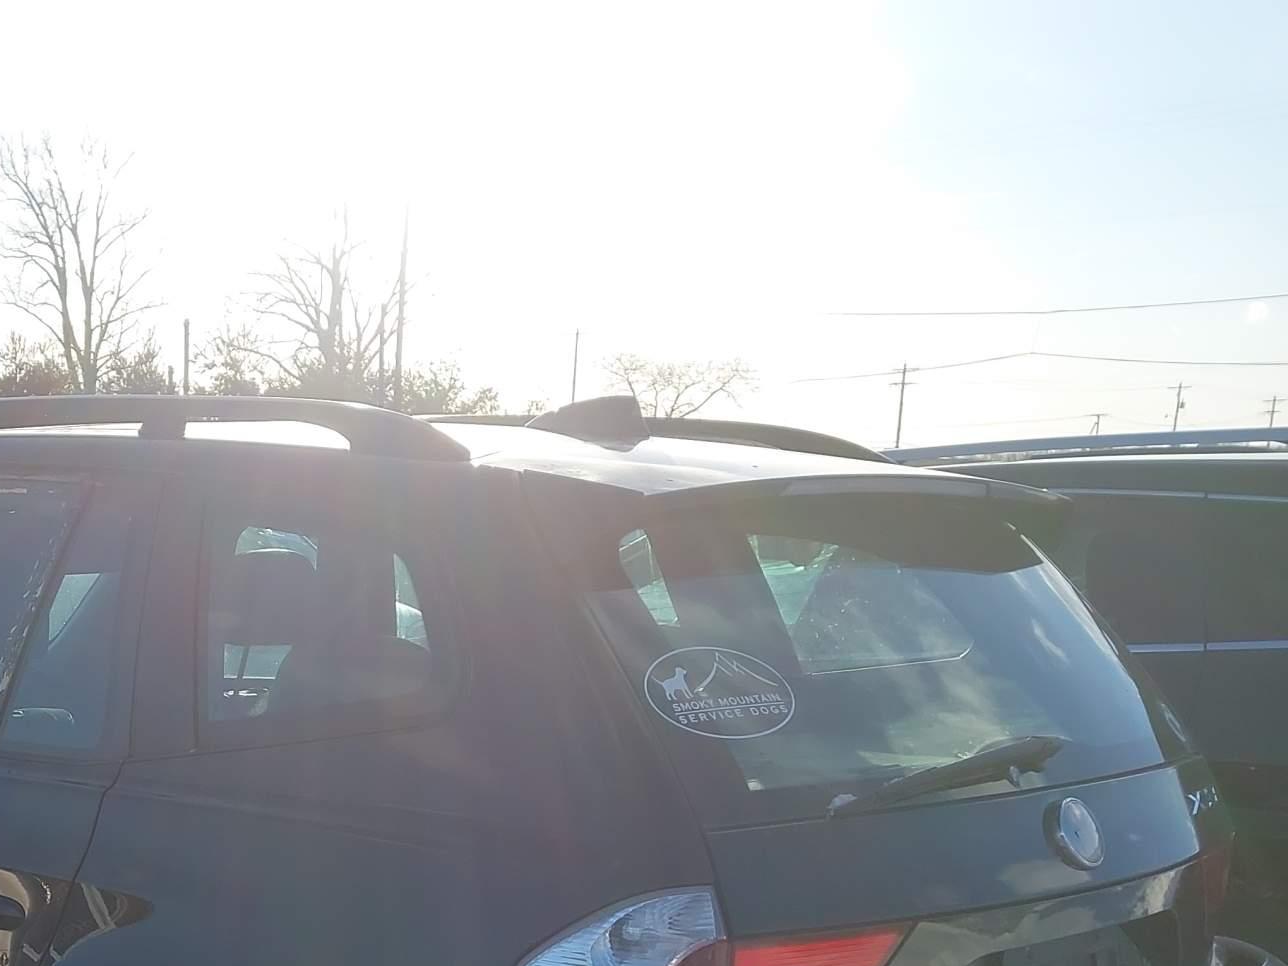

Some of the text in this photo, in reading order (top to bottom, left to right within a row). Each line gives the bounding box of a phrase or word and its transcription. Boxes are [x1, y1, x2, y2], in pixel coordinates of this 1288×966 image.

[672, 693, 781, 712] SMOKY MOUNTAIN
[678, 704, 789, 725] SERVICE DOGS
